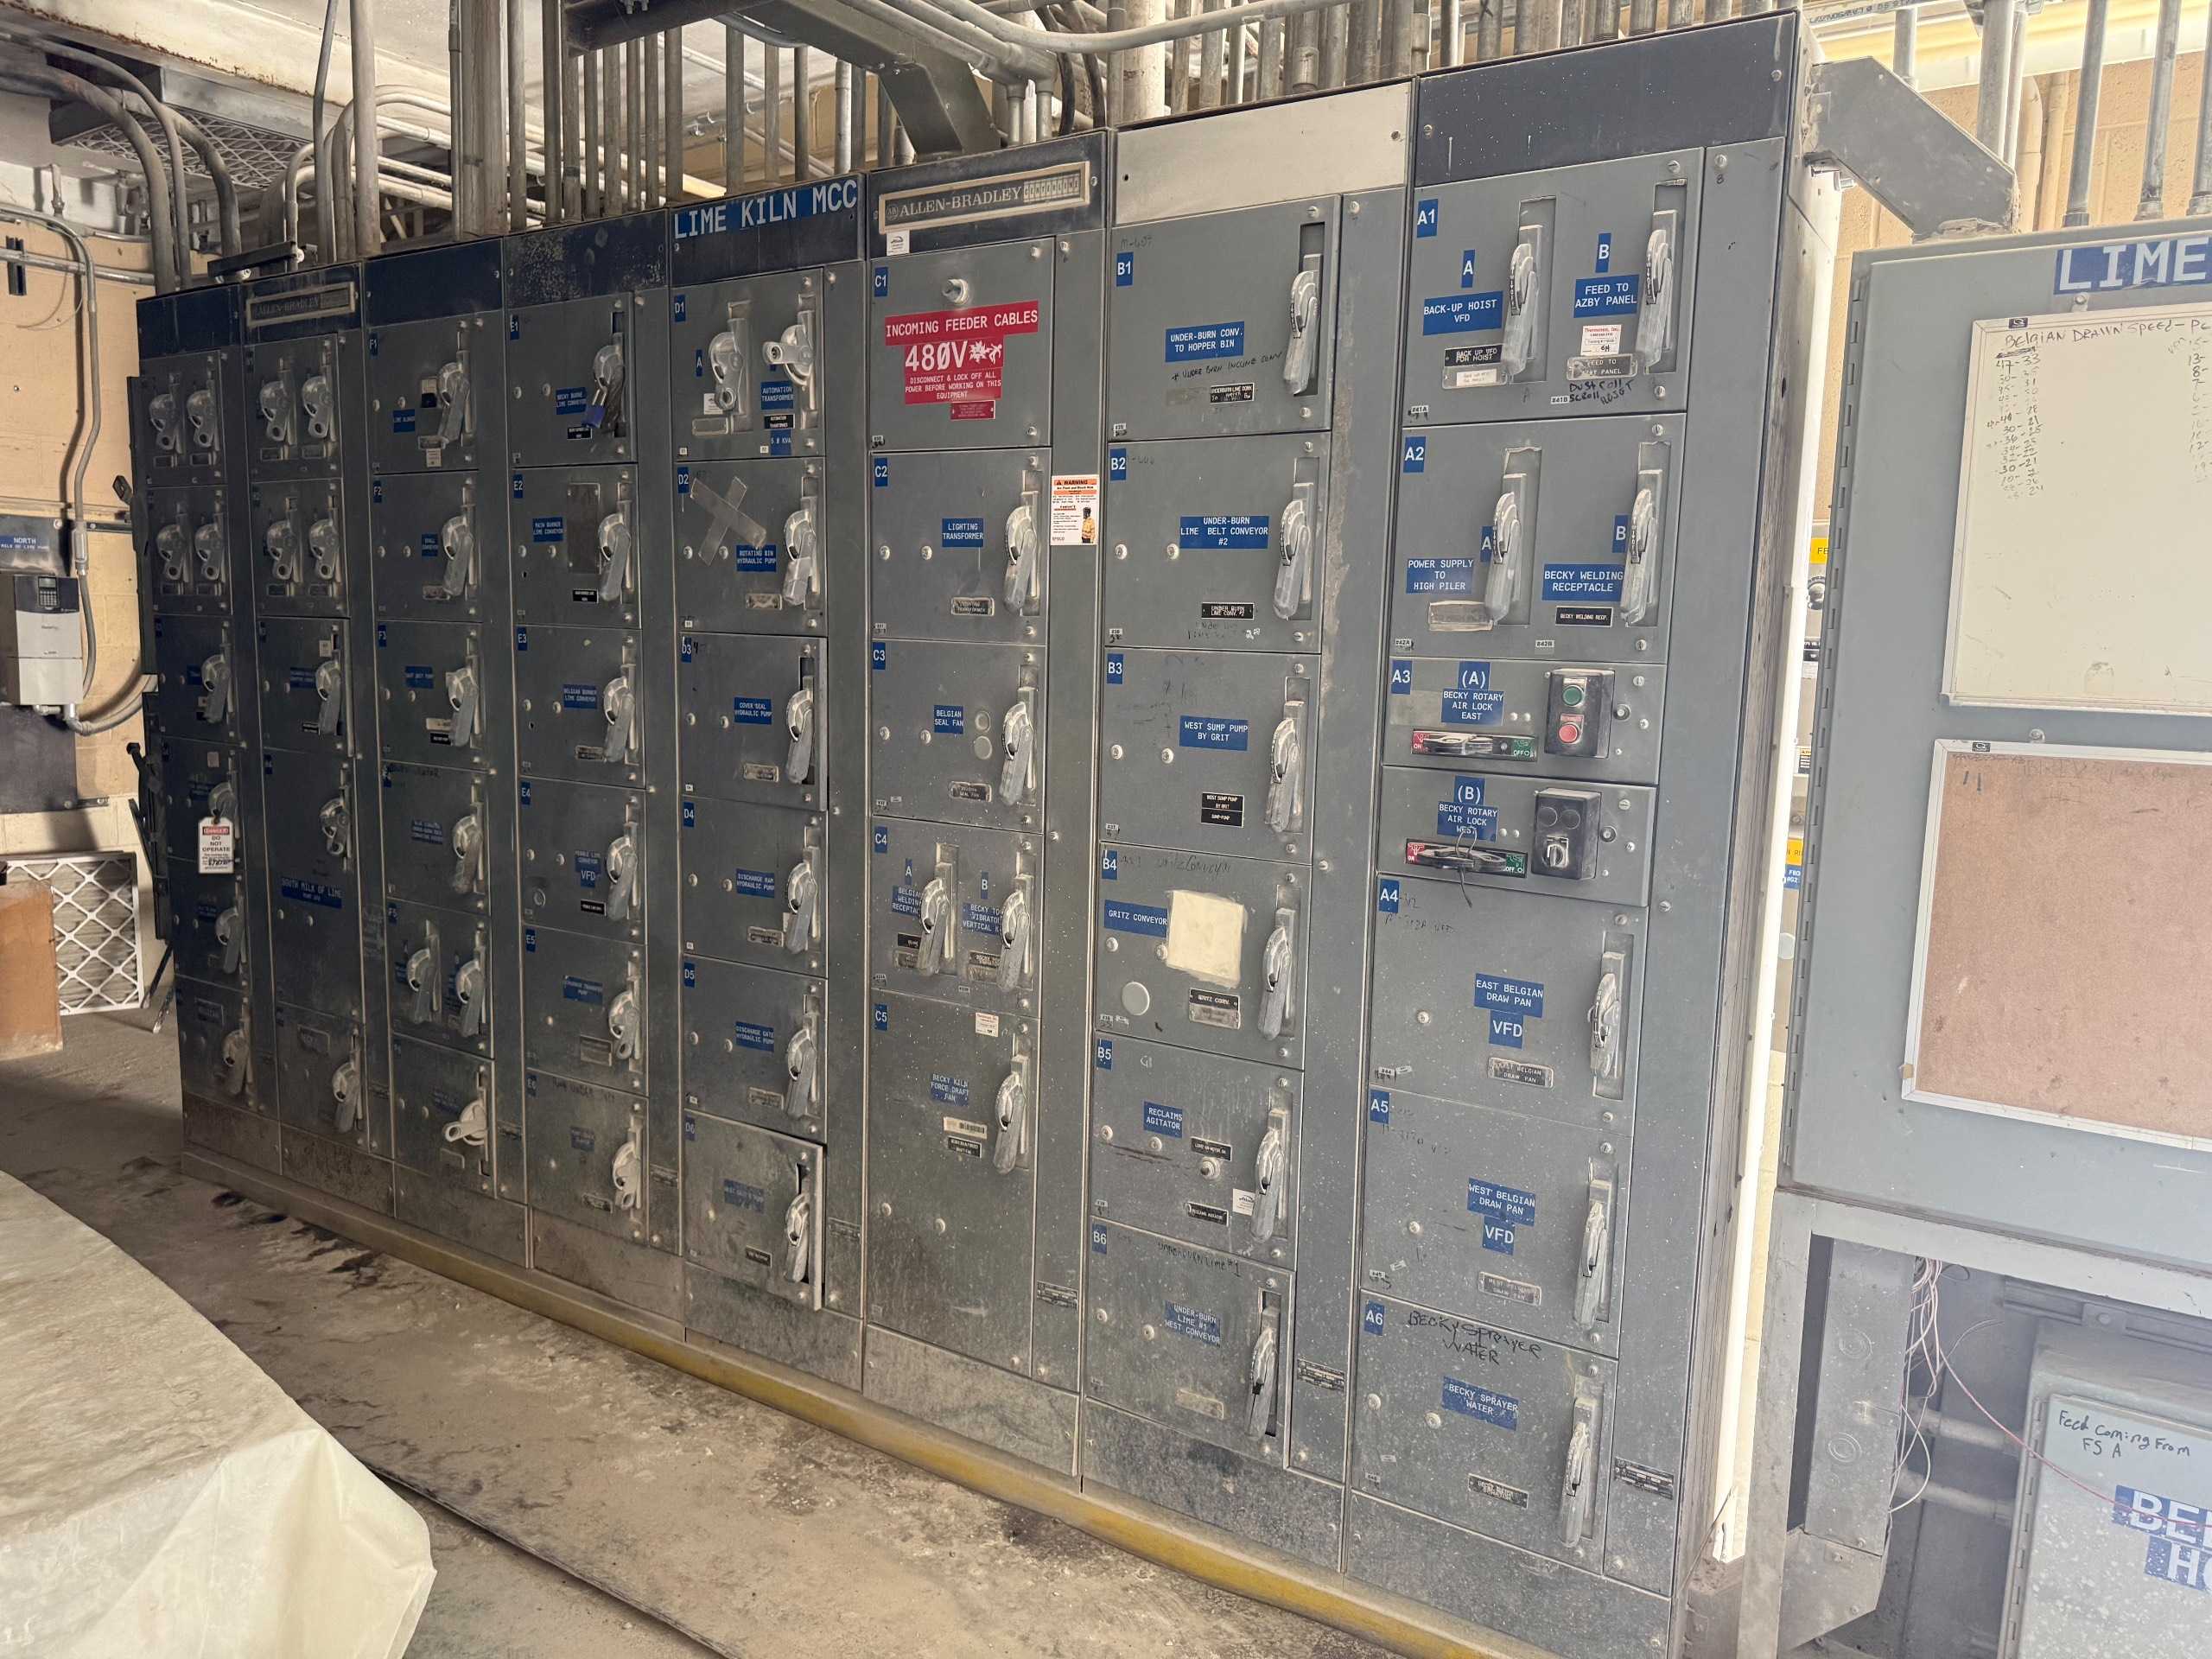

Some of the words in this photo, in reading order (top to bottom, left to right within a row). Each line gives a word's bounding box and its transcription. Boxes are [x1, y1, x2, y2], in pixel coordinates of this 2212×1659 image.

[899, 187, 1022, 216] ALLEN-BRADLEY
[674, 205, 727, 238] LIME
[741, 191, 797, 228] KILN
[812, 179, 857, 214] MCC
[1418, 209, 1436, 226] A1
[1599, 244, 1610, 259] B
[1117, 261, 1131, 275] B1
[1463, 260, 1473, 275] A
[2058, 236, 2211, 291] LIME
[874, 276, 887, 287] C1
[1585, 284, 1611, 296] FEED
[1617, 282, 1630, 293] TO
[1424, 302, 1463, 315] BACK-UP
[1468, 299, 1497, 310] HOIST
[1574, 296, 1602, 308] AZBY
[1605, 294, 1637, 306] PANEL
[675, 302, 685, 314] D1
[887, 321, 939, 337] INCOMING
[945, 315, 988, 332] FEEDER
[995, 309, 1038, 327] CABLES
[1454, 313, 1470, 323] VFD
[511, 321, 518, 332] E1
[1171, 330, 1217, 342] UNDER-BURN
[1220, 327, 1243, 337] CONV.
[1175, 344, 1185, 353] TO
[1188, 341, 1216, 352] HOPPER
[1220, 339, 1235, 348] BIN
[696, 359, 702, 367] A
[949, 382, 973, 391] WORKING
[1405, 447, 1424, 461] A2
[1110, 458, 1126, 470] B2
[874, 465, 887, 477] C2
[678, 474, 689, 484] D2
[514, 480, 523, 491] E2
[1180, 527, 1198, 536] LIME
[1207, 527, 1226, 536] BELT
[1230, 527, 1268, 536] CONVEYOR
[1617, 525, 1626, 540] B
[1218, 537, 1229, 546] #2
[1481, 537, 1492, 550] A
[1408, 559, 1435, 569] POWER
[1440, 559, 1473, 569] SUPPLY
[1434, 570, 1446, 580] TO
[1544, 570, 1575, 581] BECKY
[1580, 570, 1624, 581] WELDING
[1414, 582, 1434, 590] HIGH
[1439, 582, 1465, 591] PILER
[1553, 582, 1613, 592] RECEPTACLE
[518, 634, 527, 643] E3
[682, 645, 691, 654] D3
[873, 650, 886, 661] C3
[1108, 662, 1122, 674] B3
[1392, 671, 1411, 683] A3
[1461, 671, 1486, 689] (A)
[1444, 690, 1469, 700] BECKY
[1472, 692, 1503, 701] ROTARY
[1472, 702, 1493, 710] LOCK
[1185, 721, 1203, 730] WEST
[1207, 722, 1226, 731] SUMP
[1230, 723, 1249, 733] PUMP
[1211, 733, 1230, 741] GRIT
[522, 788, 531, 798] E4
[1458, 785, 1481, 803] (B)
[684, 809, 694, 818] D4
[1440, 804, 1464, 814] BECKY
[1467, 806, 1497, 817] ROTARY
[1447, 815, 1463, 823] AIR
[1467, 817, 1487, 826] LOCK
[1457, 825, 1476, 834] WEST
[875, 834, 887, 845] C4
[1103, 858, 1117, 871] B4
[581, 871, 595, 881] VFD
[906, 868, 912, 876] A
[982, 880, 988, 890] B
[1380, 888, 1399, 900] A4
[970, 904, 988, 912] BECKY
[1109, 910, 1129, 919] GRITZ
[1133, 913, 1167, 925] CONVEYOR
[963, 920, 992, 931] VERTICAL
[526, 935, 536, 944] E5
[684, 969, 695, 979] D5
[1476, 980, 1498, 990] EAST
[1503, 983, 1543, 998] BELGIAN
[1486, 993, 1510, 1002] DRAW
[1514, 997, 1531, 1007] PAN
[875, 1011, 887, 1022] C5
[1492, 1020, 1522, 1037] VFD
[1097, 1047, 1112, 1059] B5
[932, 1074, 950, 1083] BECKY
[931, 1082, 948, 1091] FORCE
[1370, 1100, 1389, 1113] A5
[1148, 1107, 1183, 1122] RECLAIMS
[686, 1123, 695, 1134] D6
[1146, 1117, 1180, 1130] AGITATOR
[1469, 1183, 1491, 1194] WEST
[1497, 1191, 1535, 1207] BELGIAN
[1479, 1198, 1501, 1209] DRAW
[1507, 1205, 1523, 1215] PAN
[1093, 1230, 1107, 1245] B6
[1485, 1225, 1514, 1243] VFD
[1173, 1305, 1217, 1324] UNDER-BURN
[1178, 1314, 1195, 1325] LIME
[1365, 1312, 1383, 1326] A6
[1185, 1326, 1220, 1344] CONVEYOR
[1449, 1384, 1475, 1398] BECKY
[1480, 1394, 1518, 1411] SPRAYER
[1466, 1401, 1494, 1414] WATER
[2060, 1409, 2089, 1431] Feed
[2113, 1443, 2121, 1459] A
